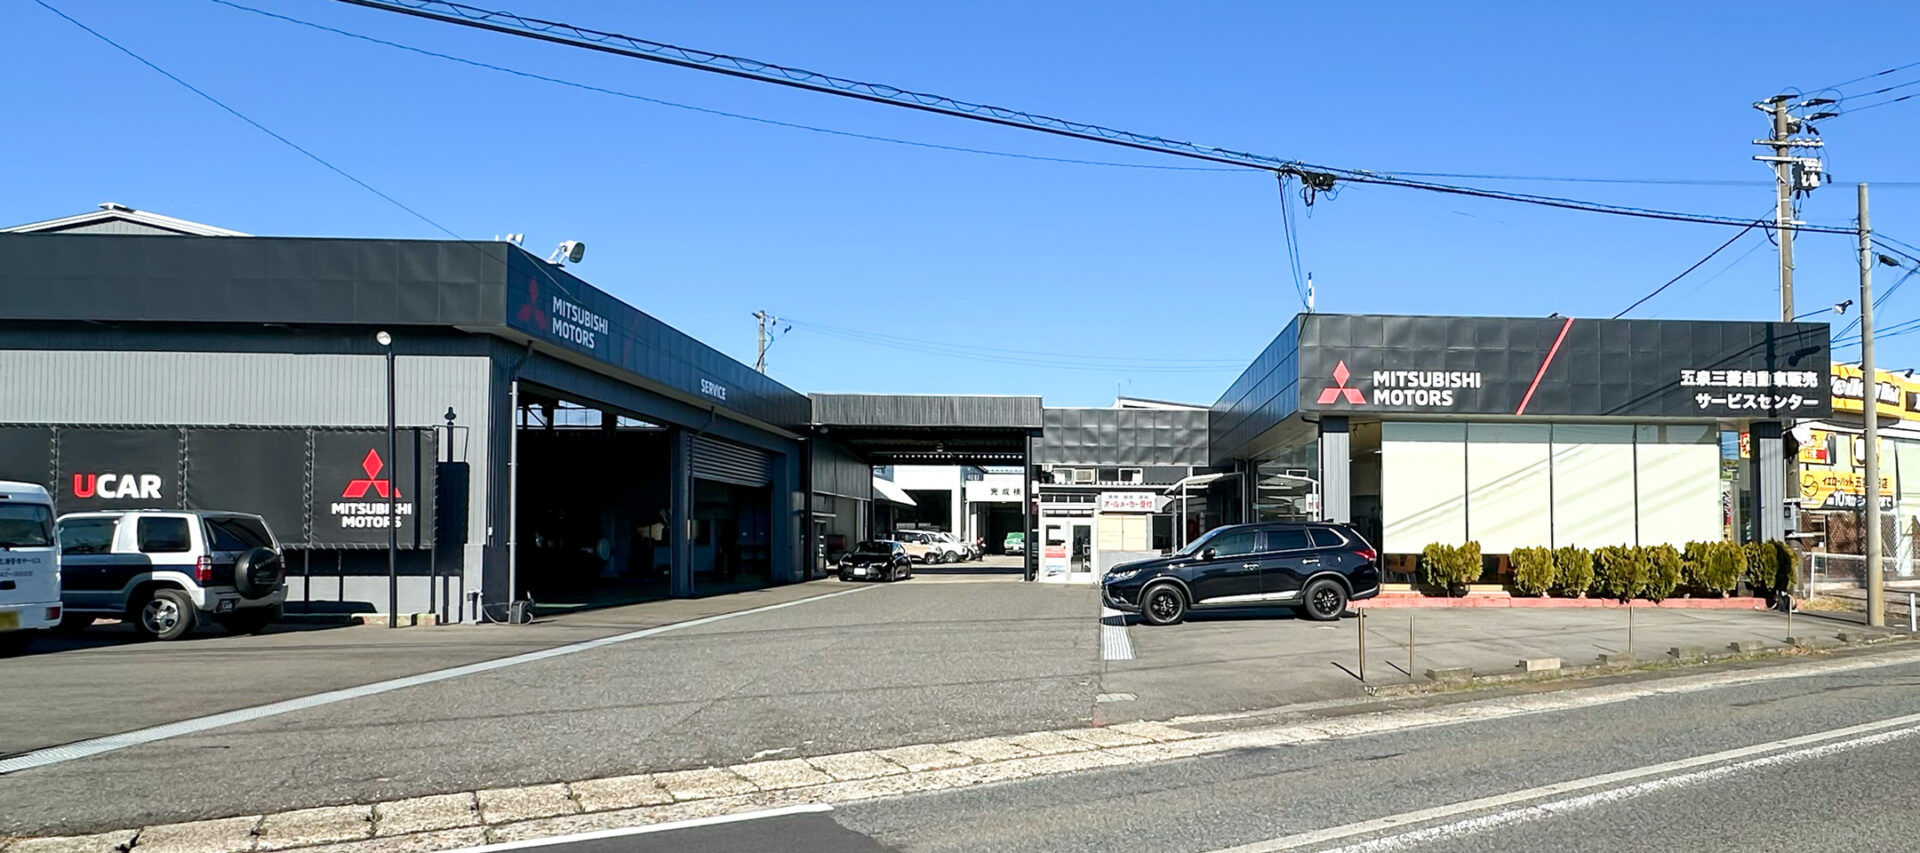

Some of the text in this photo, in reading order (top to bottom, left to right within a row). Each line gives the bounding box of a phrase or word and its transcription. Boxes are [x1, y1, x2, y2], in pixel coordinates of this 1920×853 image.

[552, 295, 609, 336] MITSUBISHI
[552, 317, 595, 350] MOTORS
[1373, 371, 1481, 388] MITSUBISHI
[1680, 370, 1818, 387] 五泉三菱自動車販売
[700, 378, 727, 400] SERVICE
[1373, 389, 1453, 406] MOTORS
[1695, 393, 1819, 410] サービスセンター
[73, 473, 162, 499] UCAR
